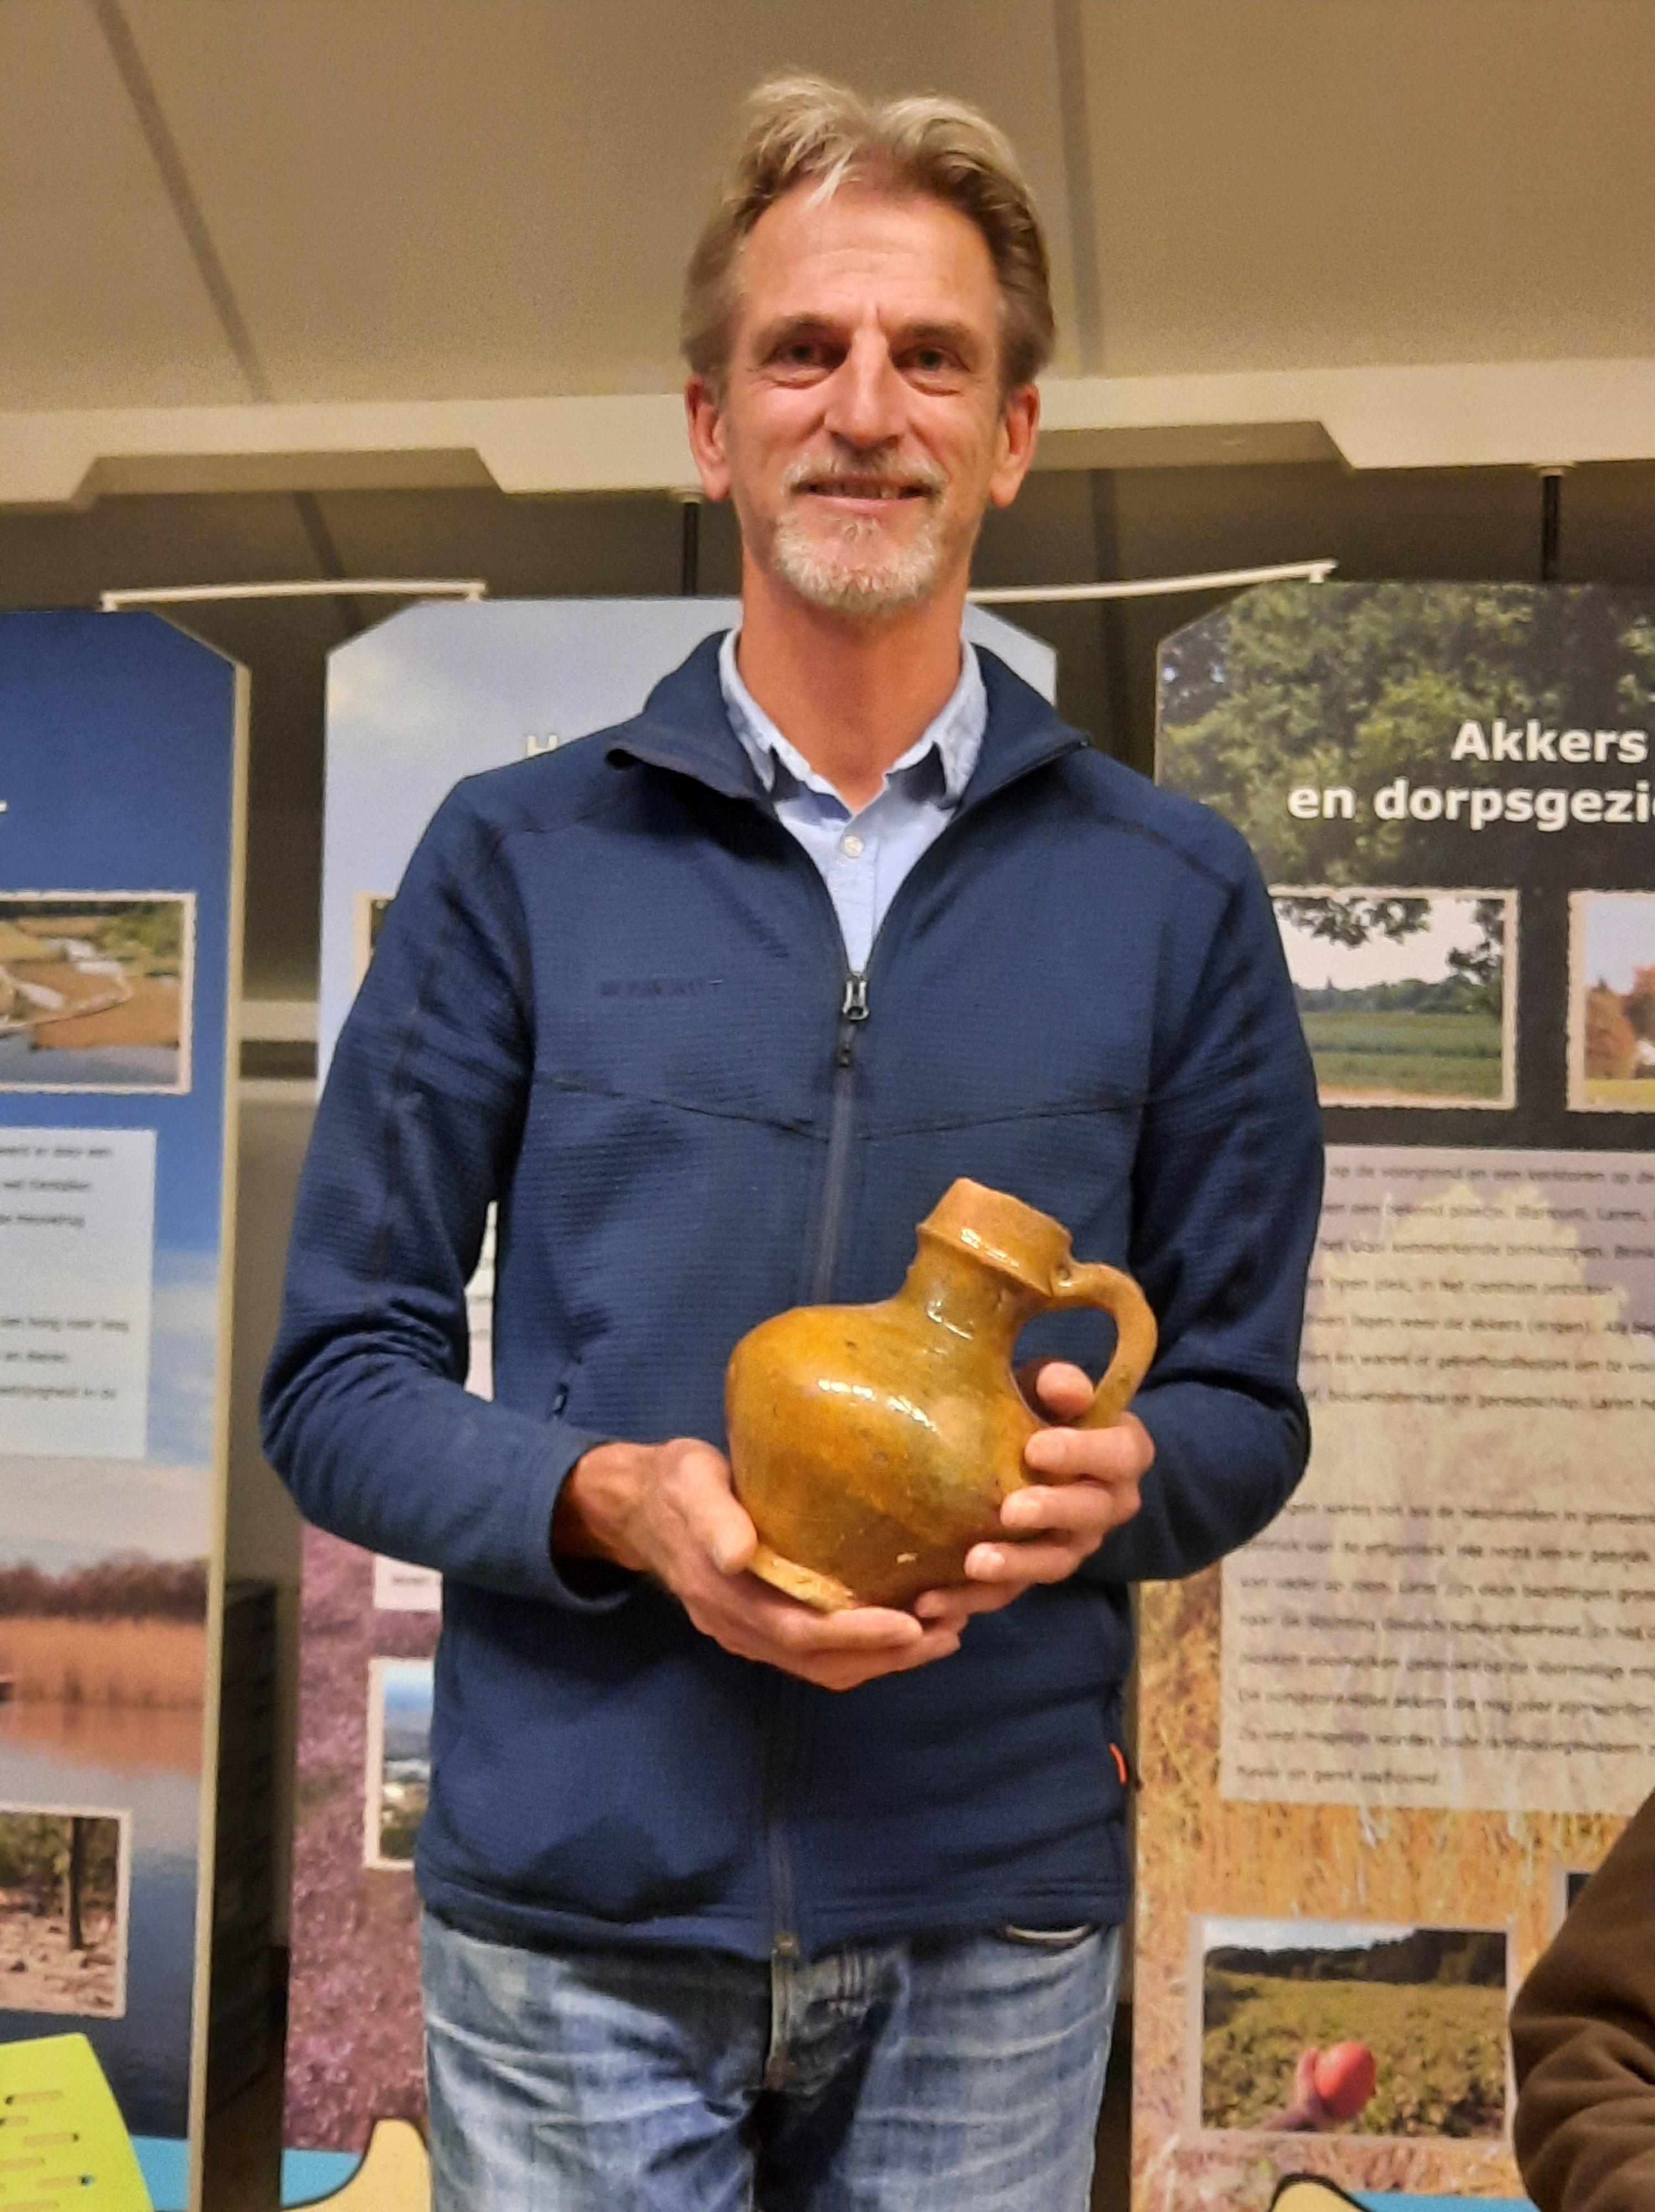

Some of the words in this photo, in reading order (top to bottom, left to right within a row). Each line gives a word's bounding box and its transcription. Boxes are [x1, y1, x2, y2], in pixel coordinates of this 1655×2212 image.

[1450, 718, 1649, 763] Akkers
[1287, 785, 1356, 820] en
[1374, 776, 1655, 832] dorpsgezi
